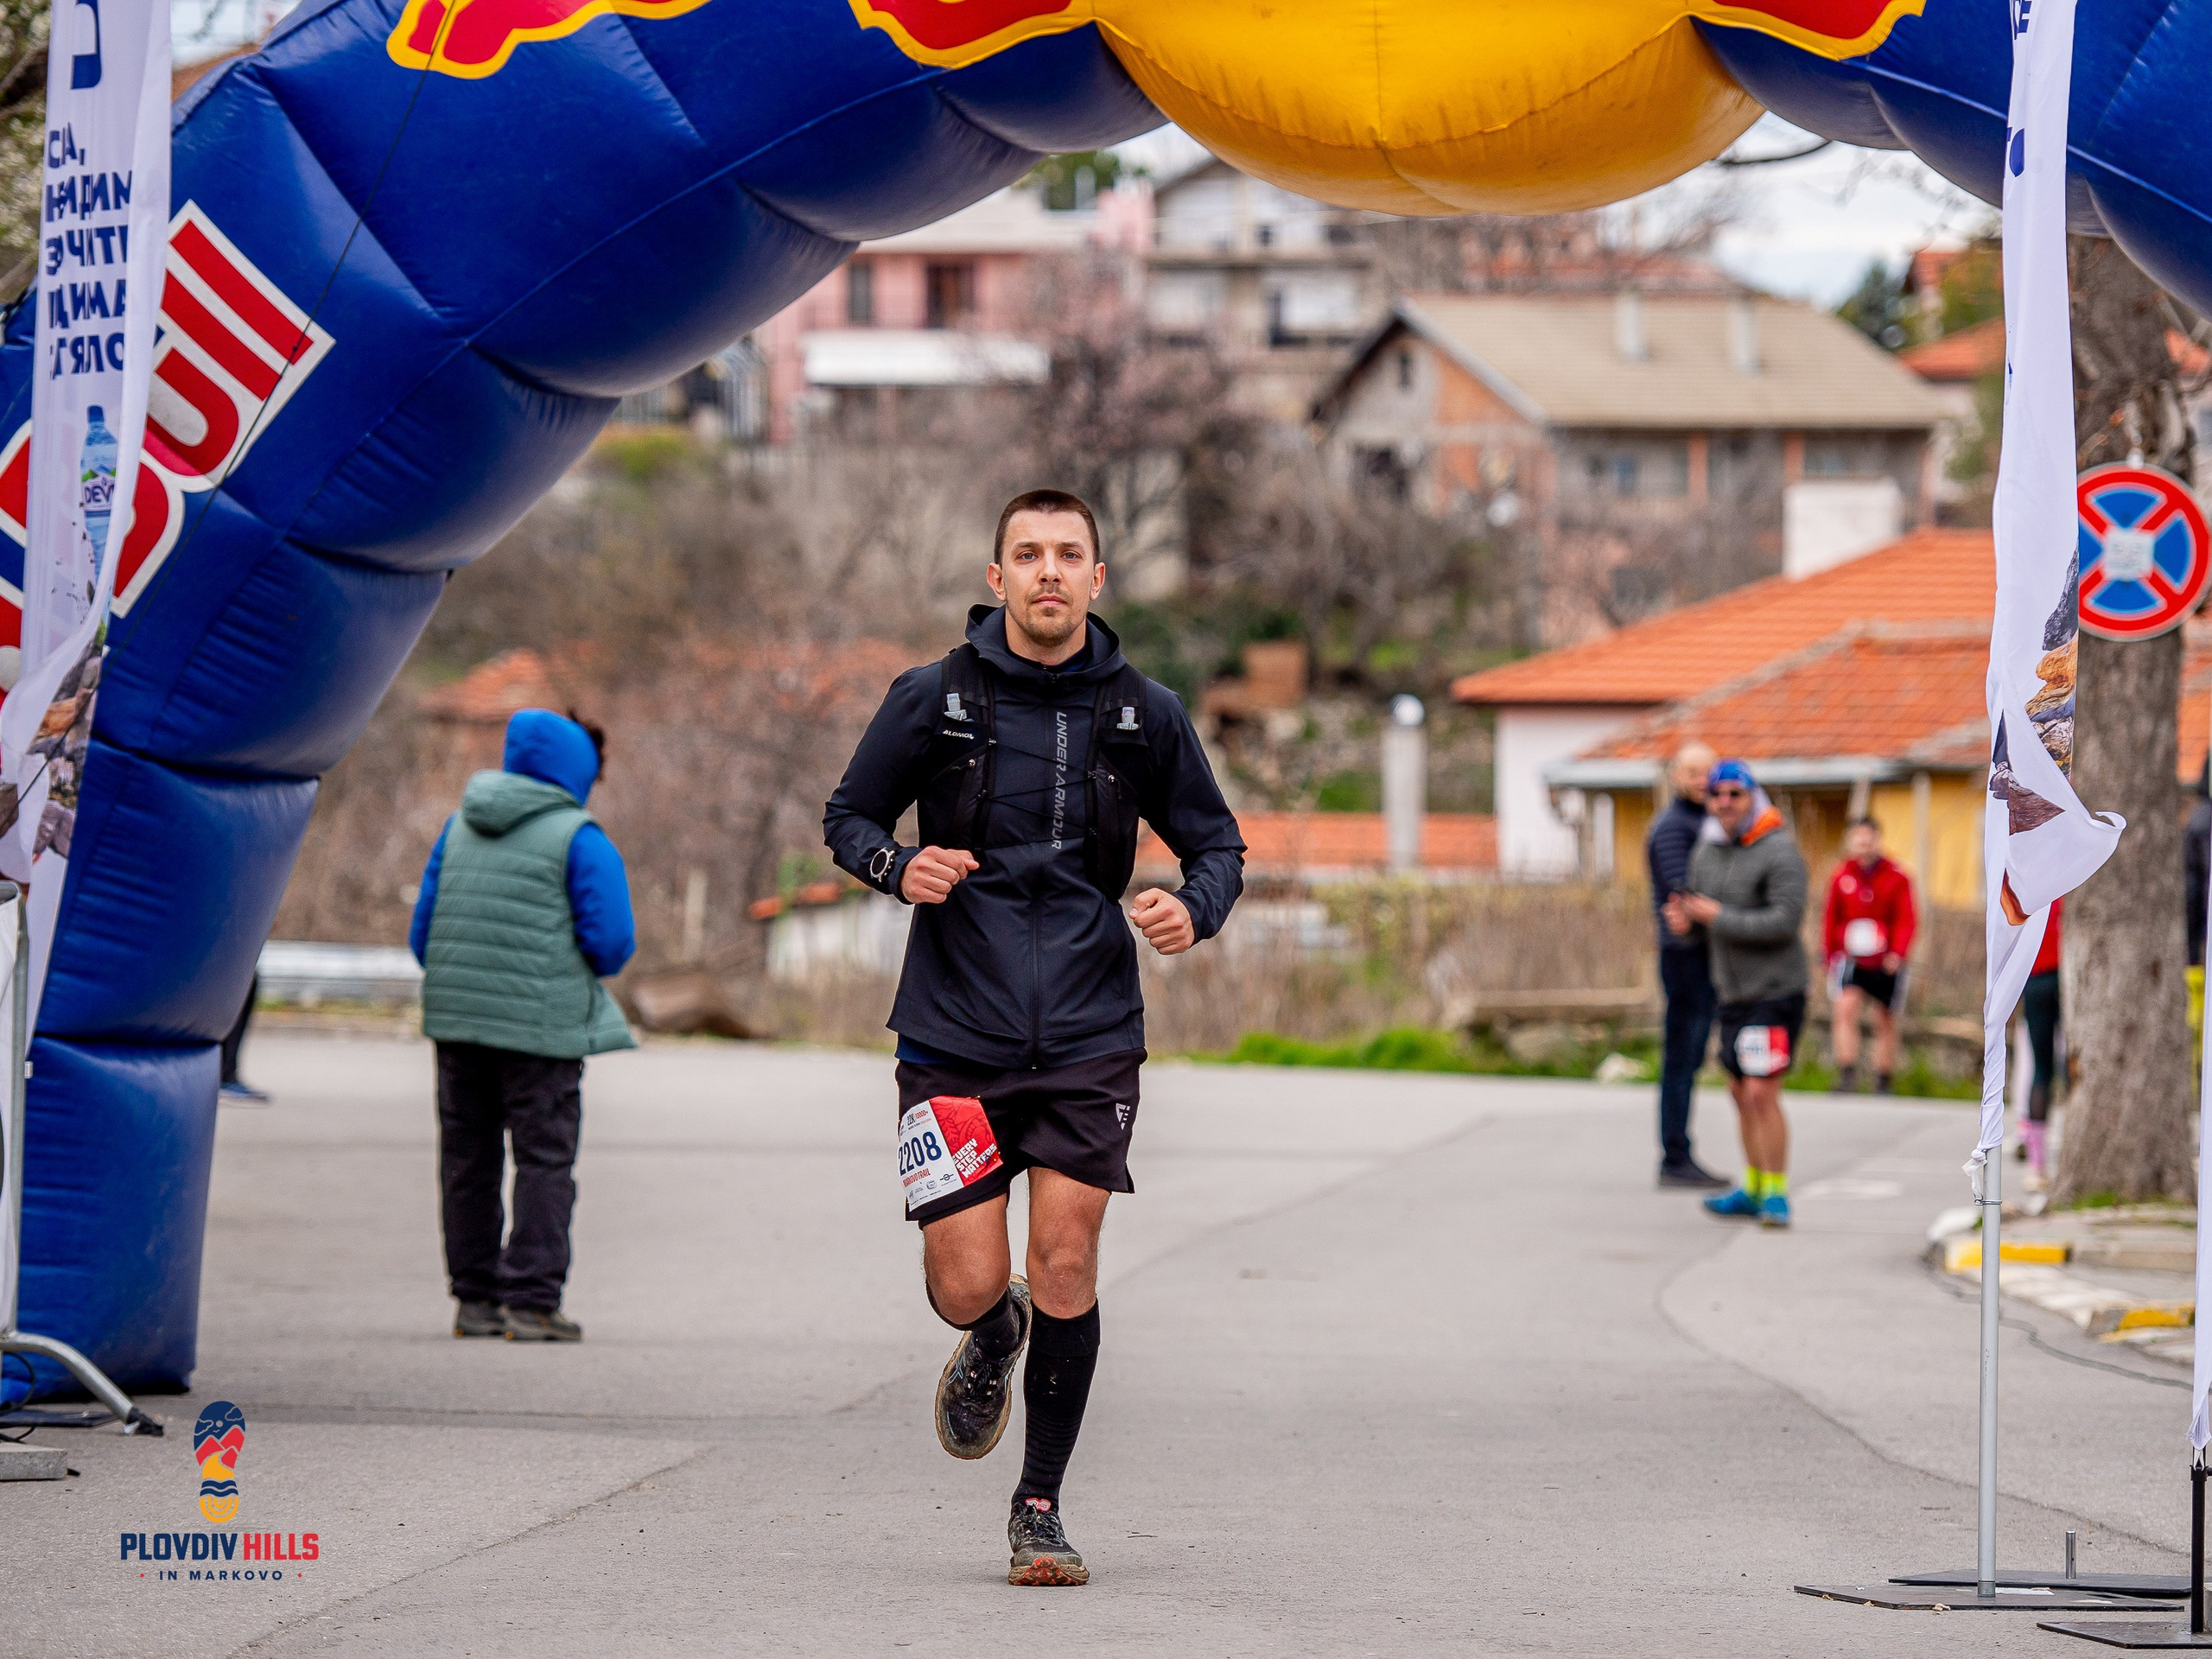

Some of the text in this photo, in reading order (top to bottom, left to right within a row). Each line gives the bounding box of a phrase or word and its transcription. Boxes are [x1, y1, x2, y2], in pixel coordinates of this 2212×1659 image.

[1052, 711, 1067, 849] UNDER ARMOUR
[898, 1131, 943, 1176] 2208
[952, 1138, 978, 1165] EVERY
[956, 1150, 977, 1172] STEP
[962, 1143, 997, 1179] MATTERS
[918, 1168, 931, 1180] TRAIL
